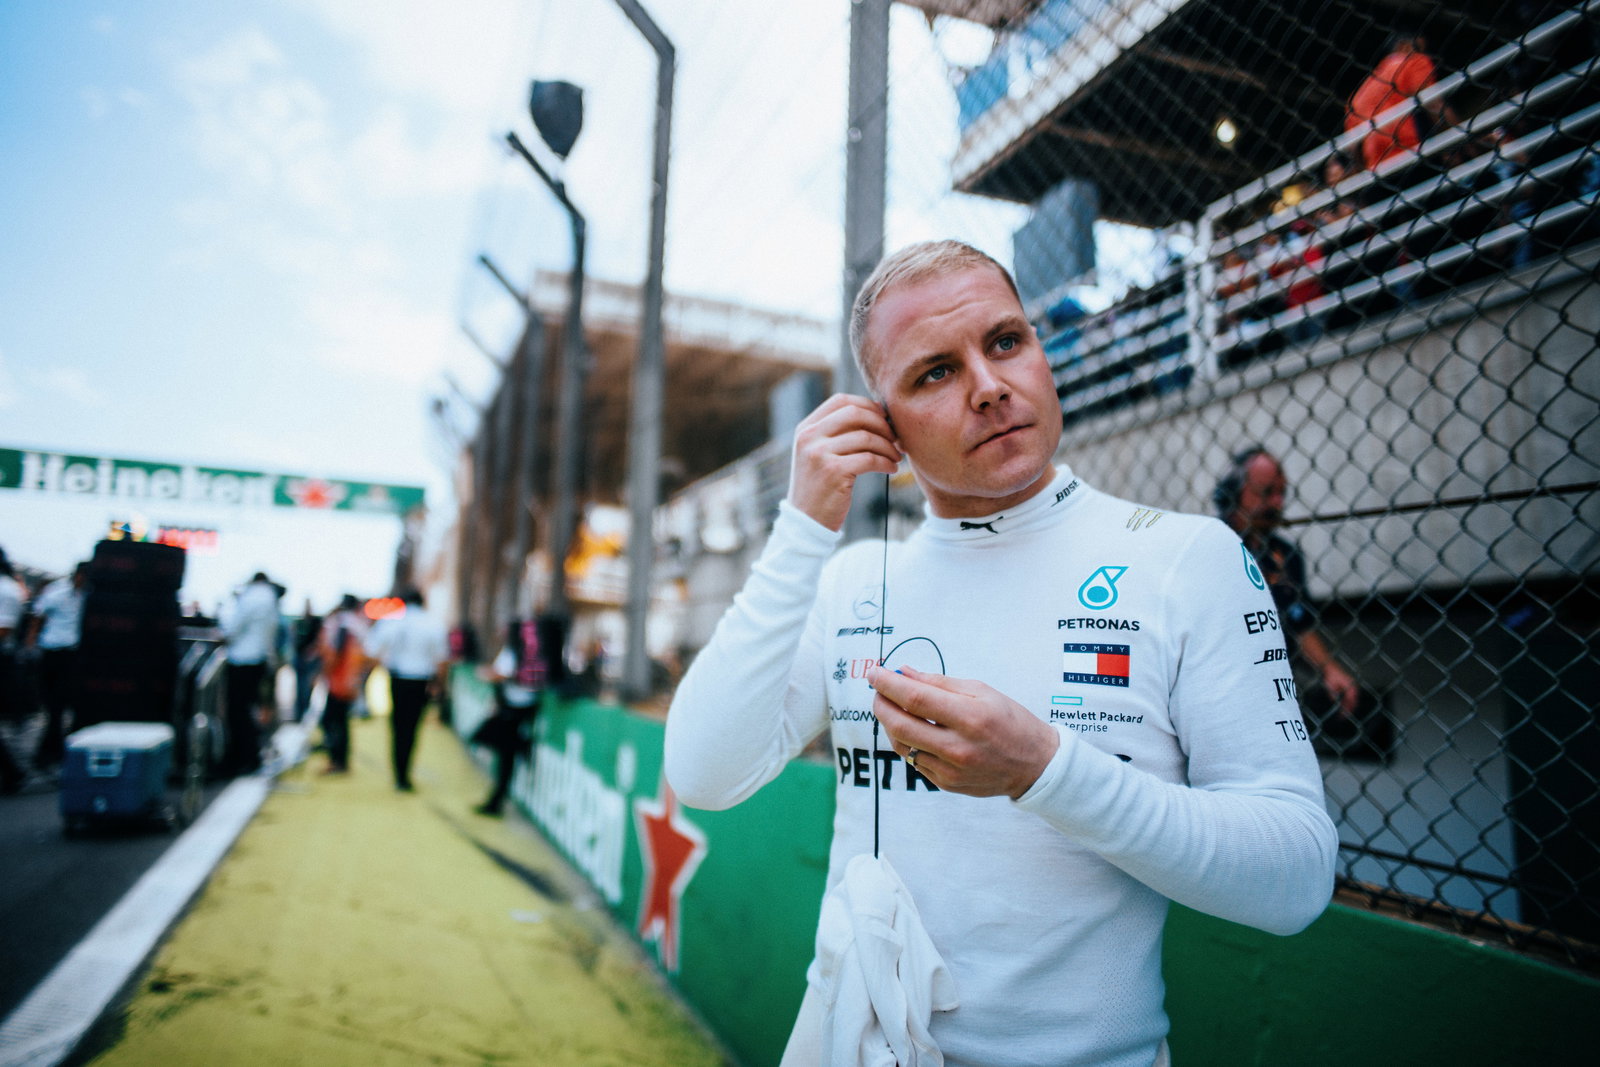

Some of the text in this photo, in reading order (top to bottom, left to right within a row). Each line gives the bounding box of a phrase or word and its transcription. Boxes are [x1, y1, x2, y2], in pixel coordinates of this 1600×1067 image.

[20, 450, 278, 505] Heineken
[1051, 479, 1080, 507] BOSE
[849, 626, 894, 635] AMG
[1058, 618, 1140, 631] PETRONAS
[1243, 609, 1281, 635] EPS
[1253, 648, 1287, 665] BOS
[1068, 675, 1124, 685] HILFIGER
[1050, 709, 1143, 724] Hewlett Packard
[1275, 719, 1307, 742] TIB
